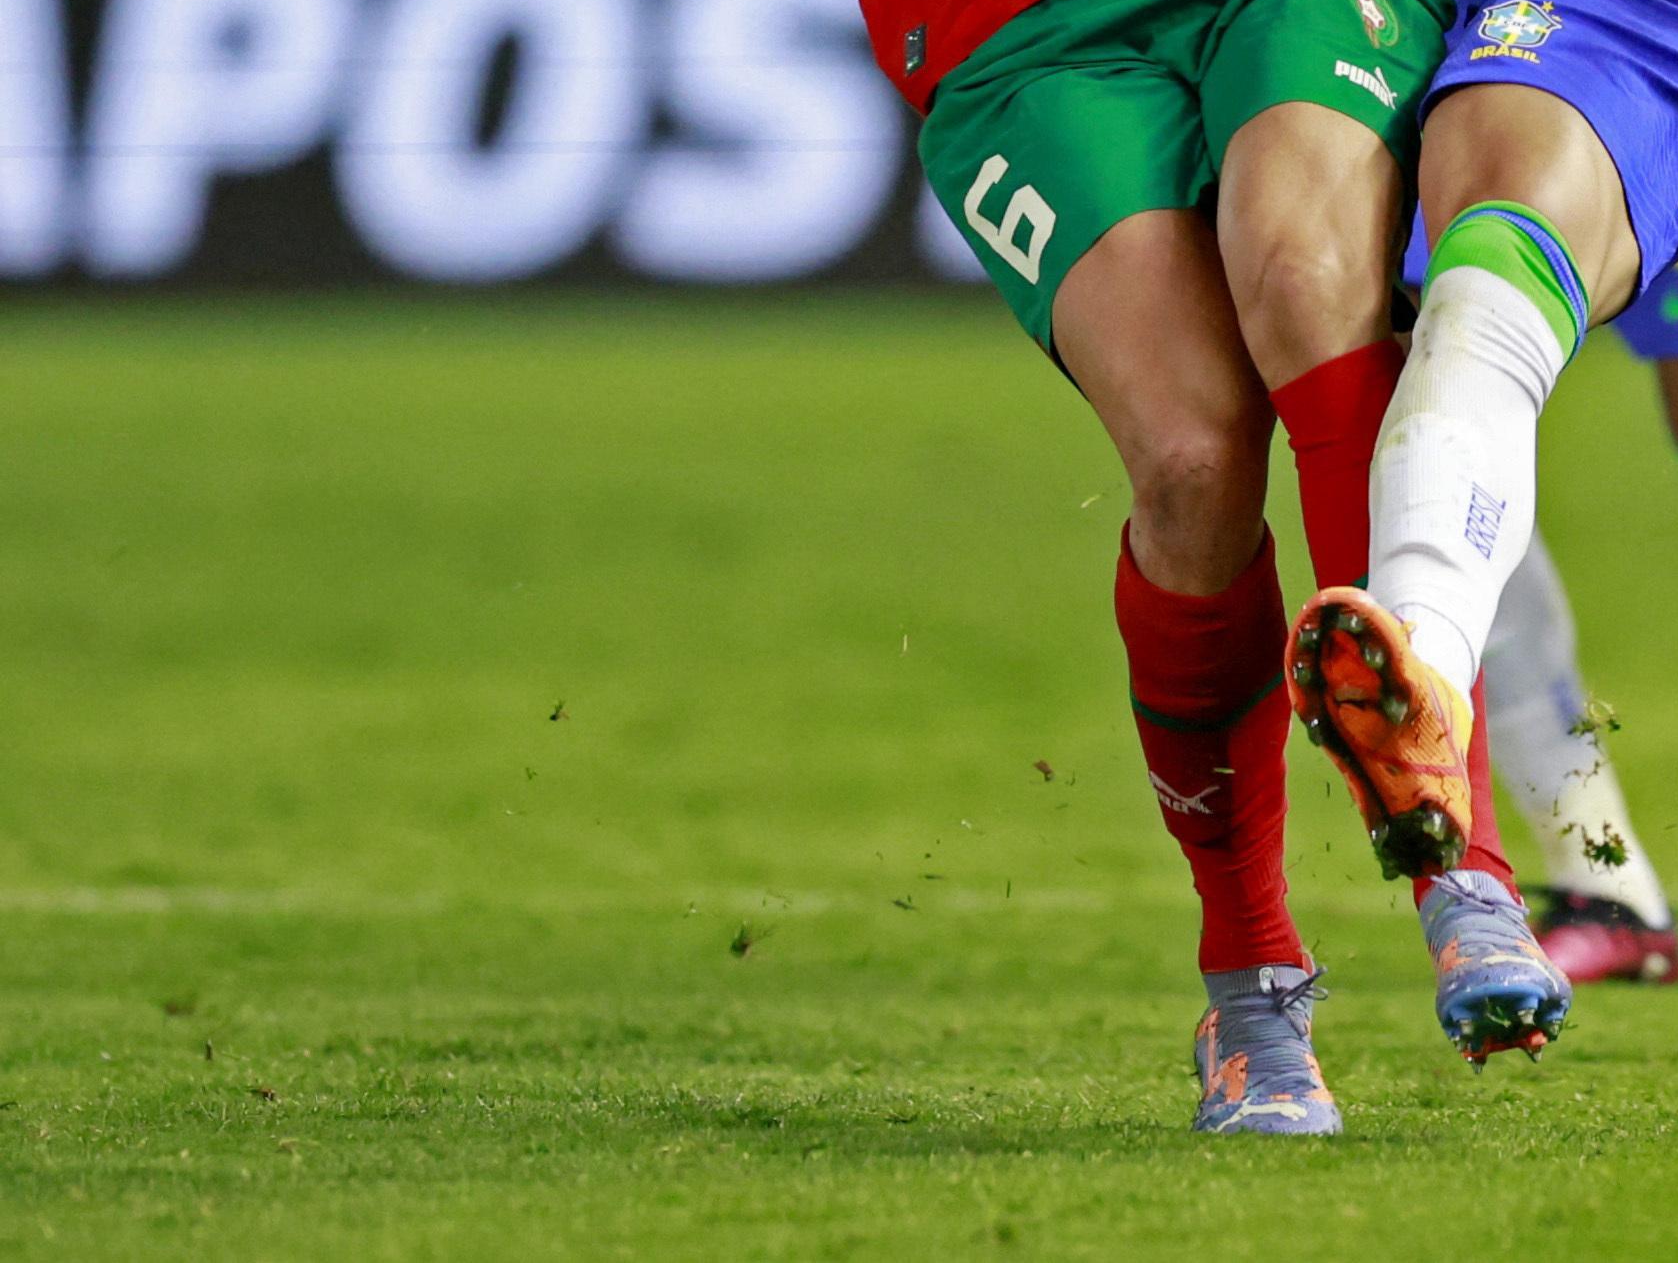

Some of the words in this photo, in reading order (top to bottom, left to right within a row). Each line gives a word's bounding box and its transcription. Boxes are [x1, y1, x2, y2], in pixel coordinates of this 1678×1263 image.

[1334, 60, 1390, 107] PUMA
[1470, 44, 1541, 64] BRASIL
[963, 154, 1057, 285] 6
[1464, 481, 1507, 560] BRASIL
